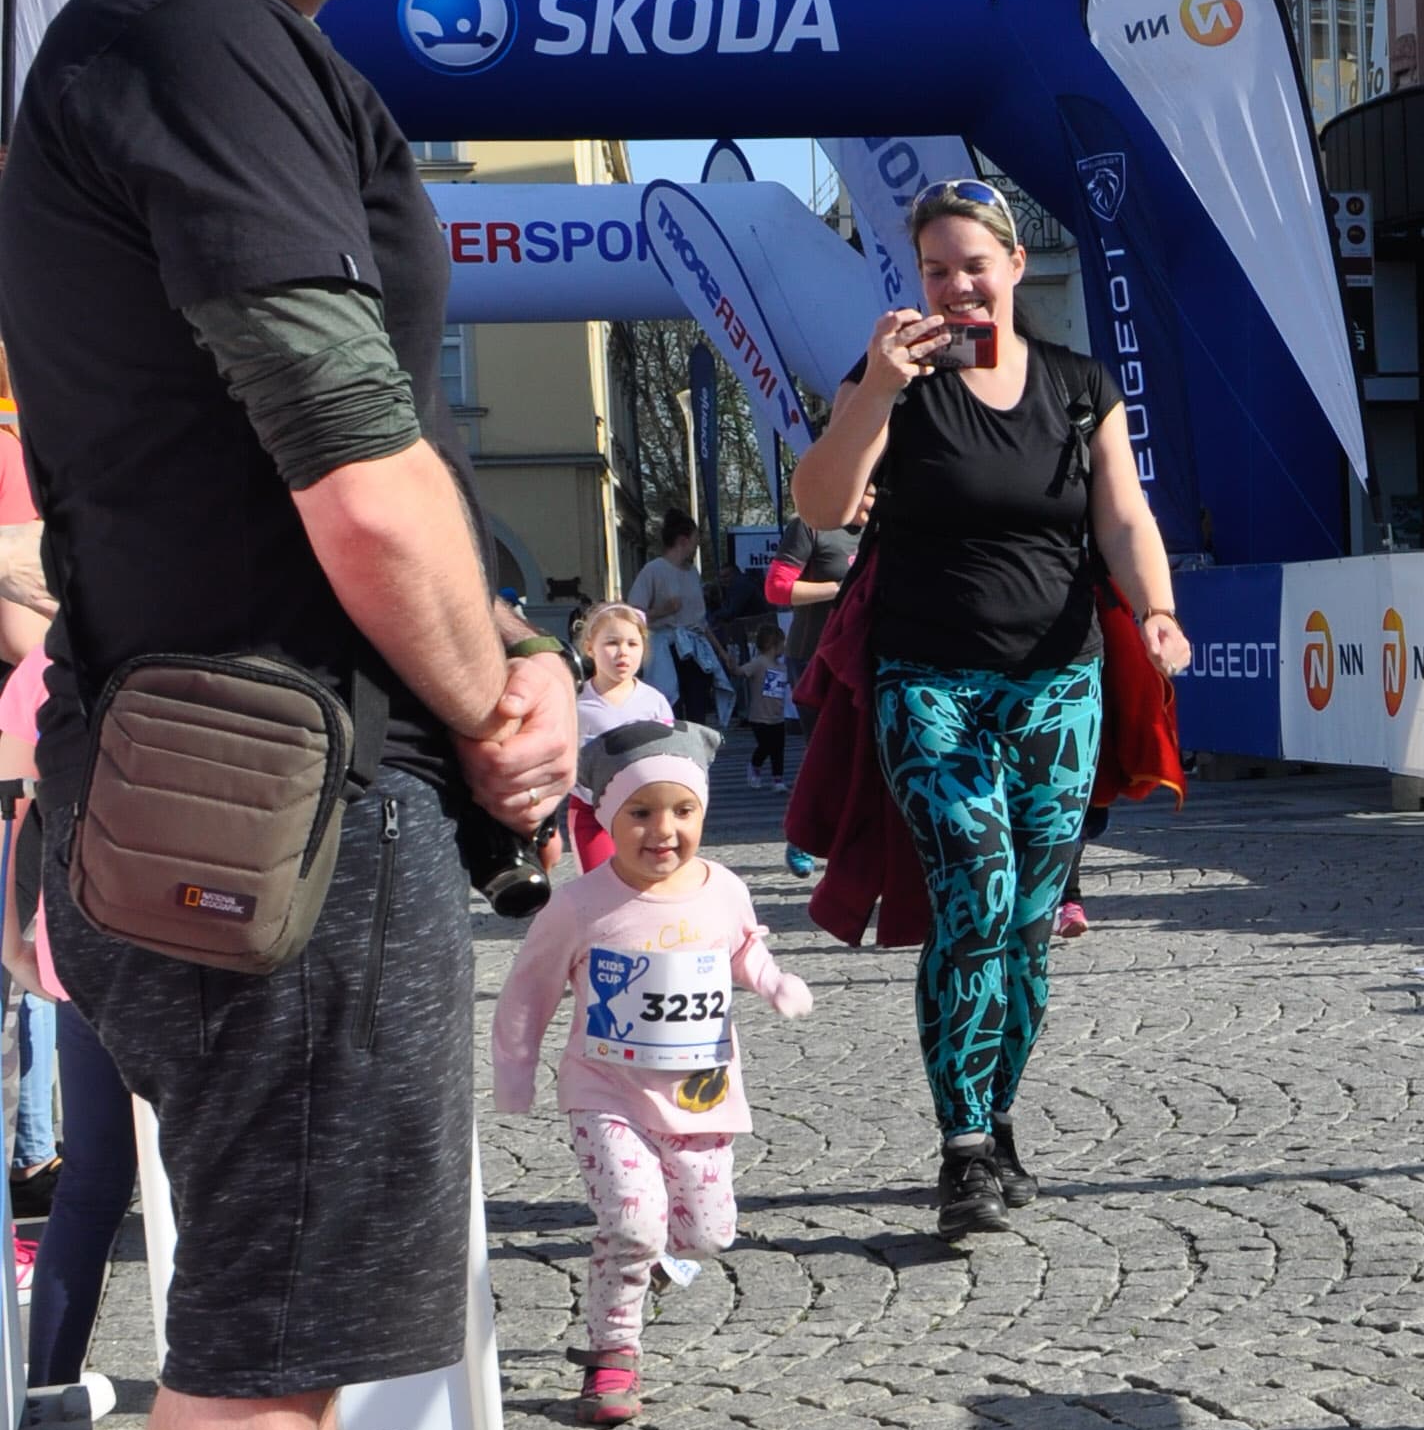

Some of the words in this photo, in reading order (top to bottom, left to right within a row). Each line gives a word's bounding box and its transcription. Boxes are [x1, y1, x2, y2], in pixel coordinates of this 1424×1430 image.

[441, 220, 650, 263] ERSPO
[1100, 237, 1157, 522] EUGEOT
[1174, 642, 1277, 678] UGEOT
[1339, 643, 1363, 676] NN
[597, 972, 622, 984] CUP
[598, 958, 625, 971] KIDS
[640, 991, 725, 1022] 3232
